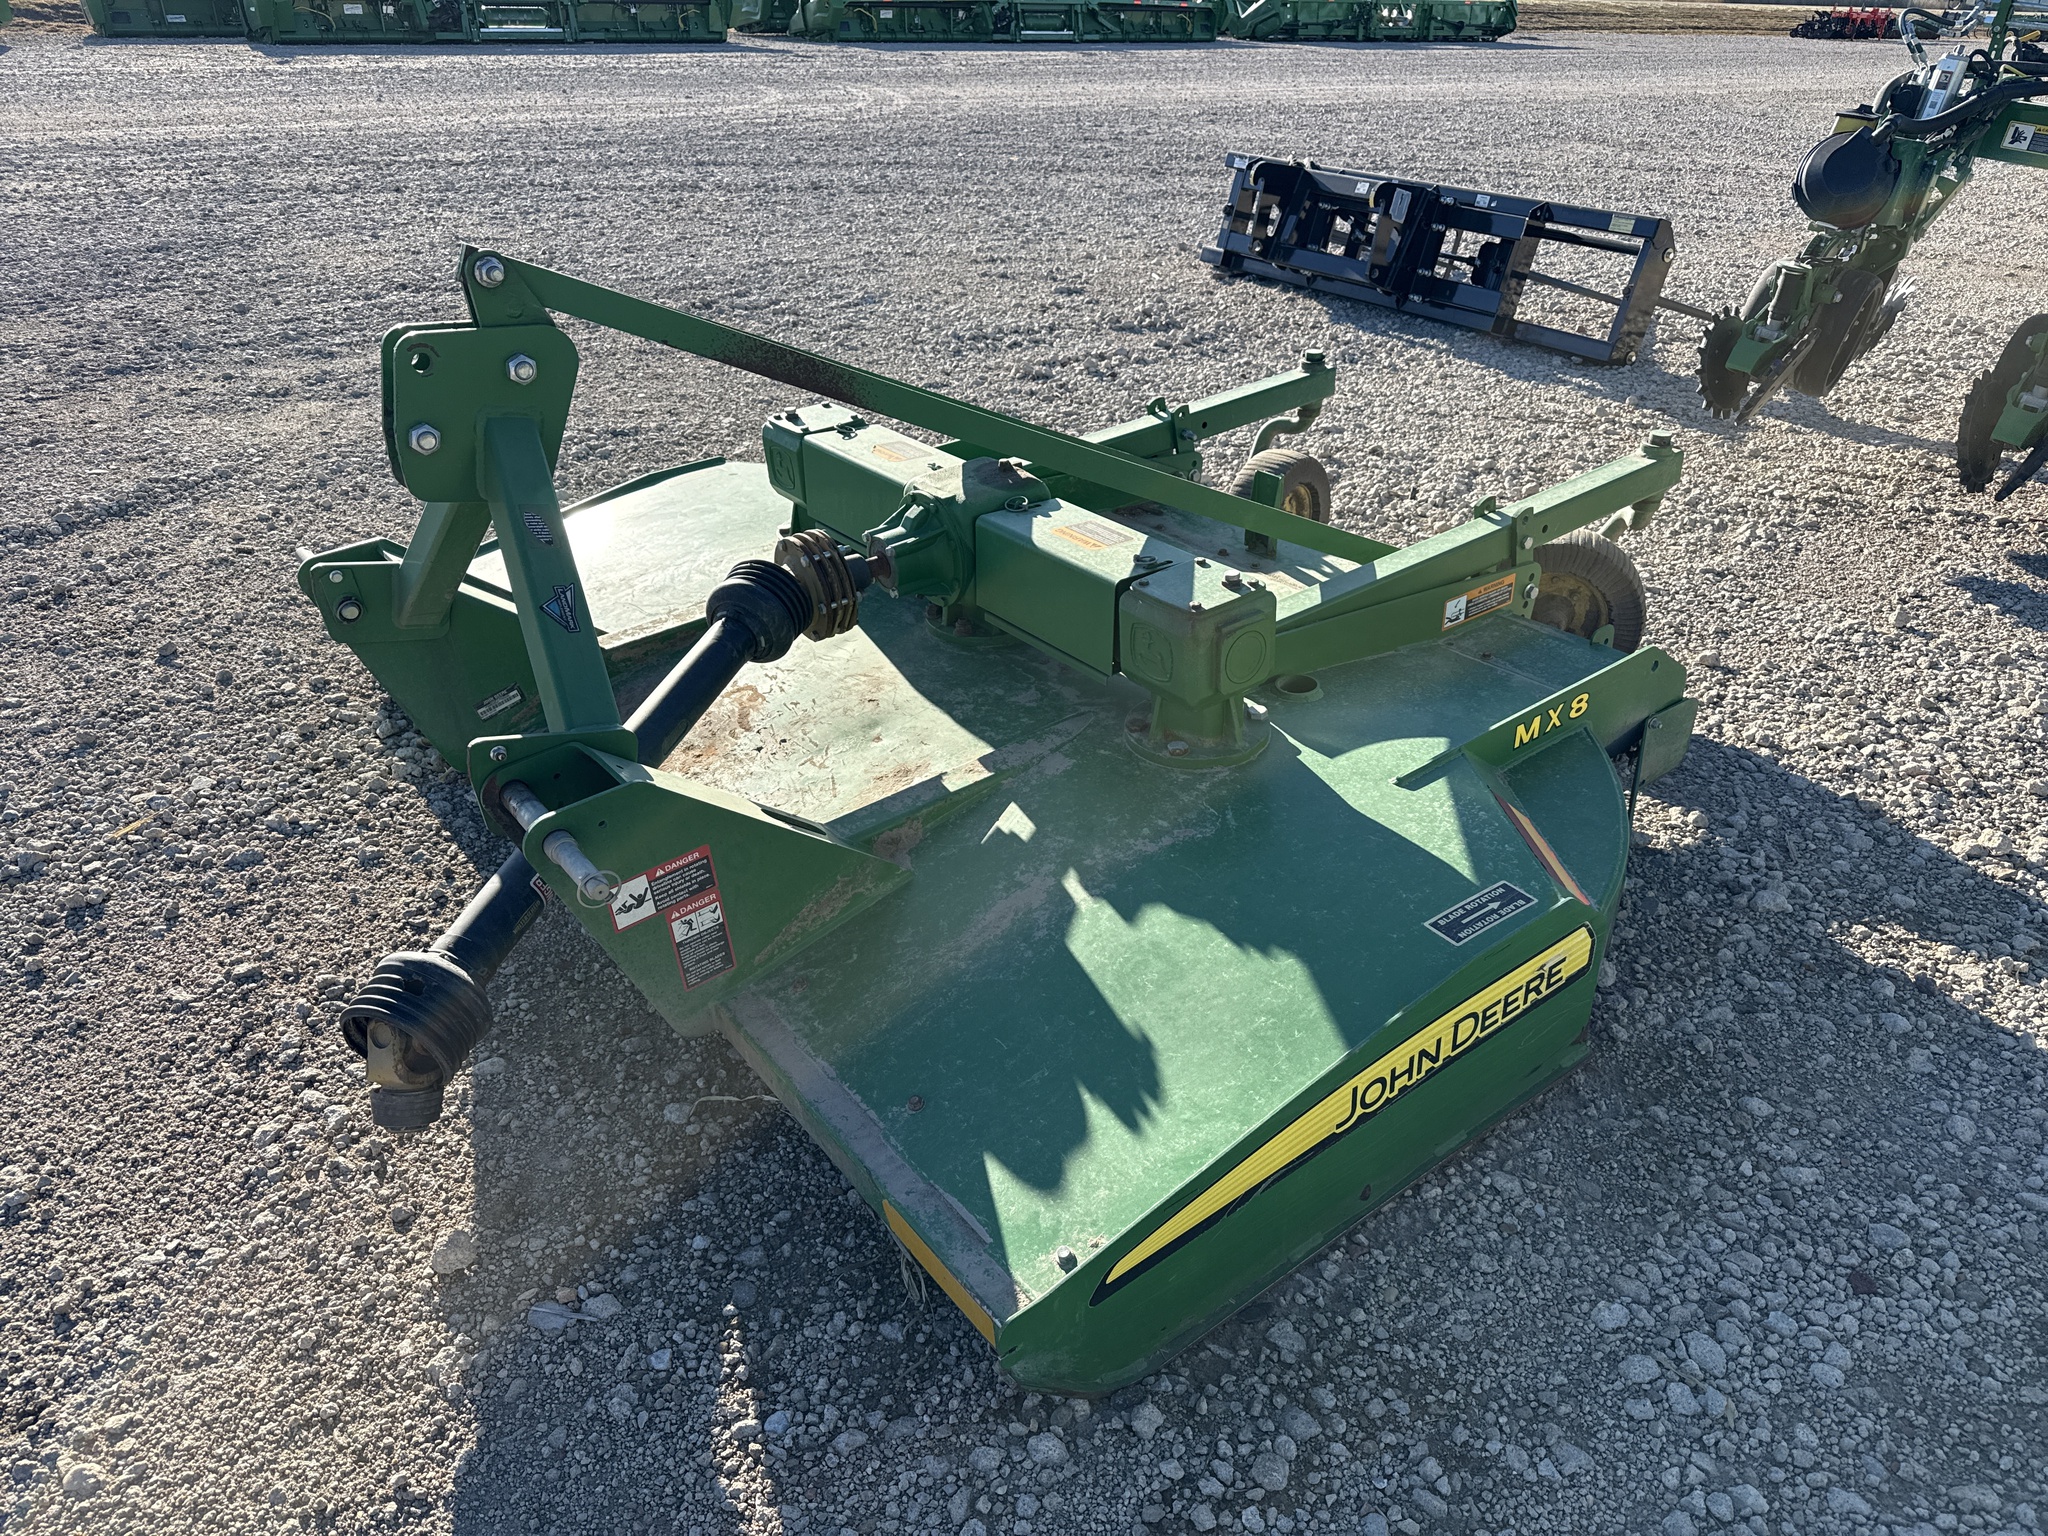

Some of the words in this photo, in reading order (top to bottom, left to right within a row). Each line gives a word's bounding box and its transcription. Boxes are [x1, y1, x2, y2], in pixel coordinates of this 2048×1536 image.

[557, 588, 577, 630] LANDMARK
[665, 852, 699, 872] DANGER
[679, 893, 716, 914] DANGER
[1438, 908, 1467, 926] BLADE
[1466, 887, 1506, 911] ROTATION
[1498, 899, 1526, 916] BLADE
[1457, 913, 1500, 938] ROTATION
[1335, 1036, 1443, 1131] JOHN
[1450, 956, 1568, 1054] DEERE
